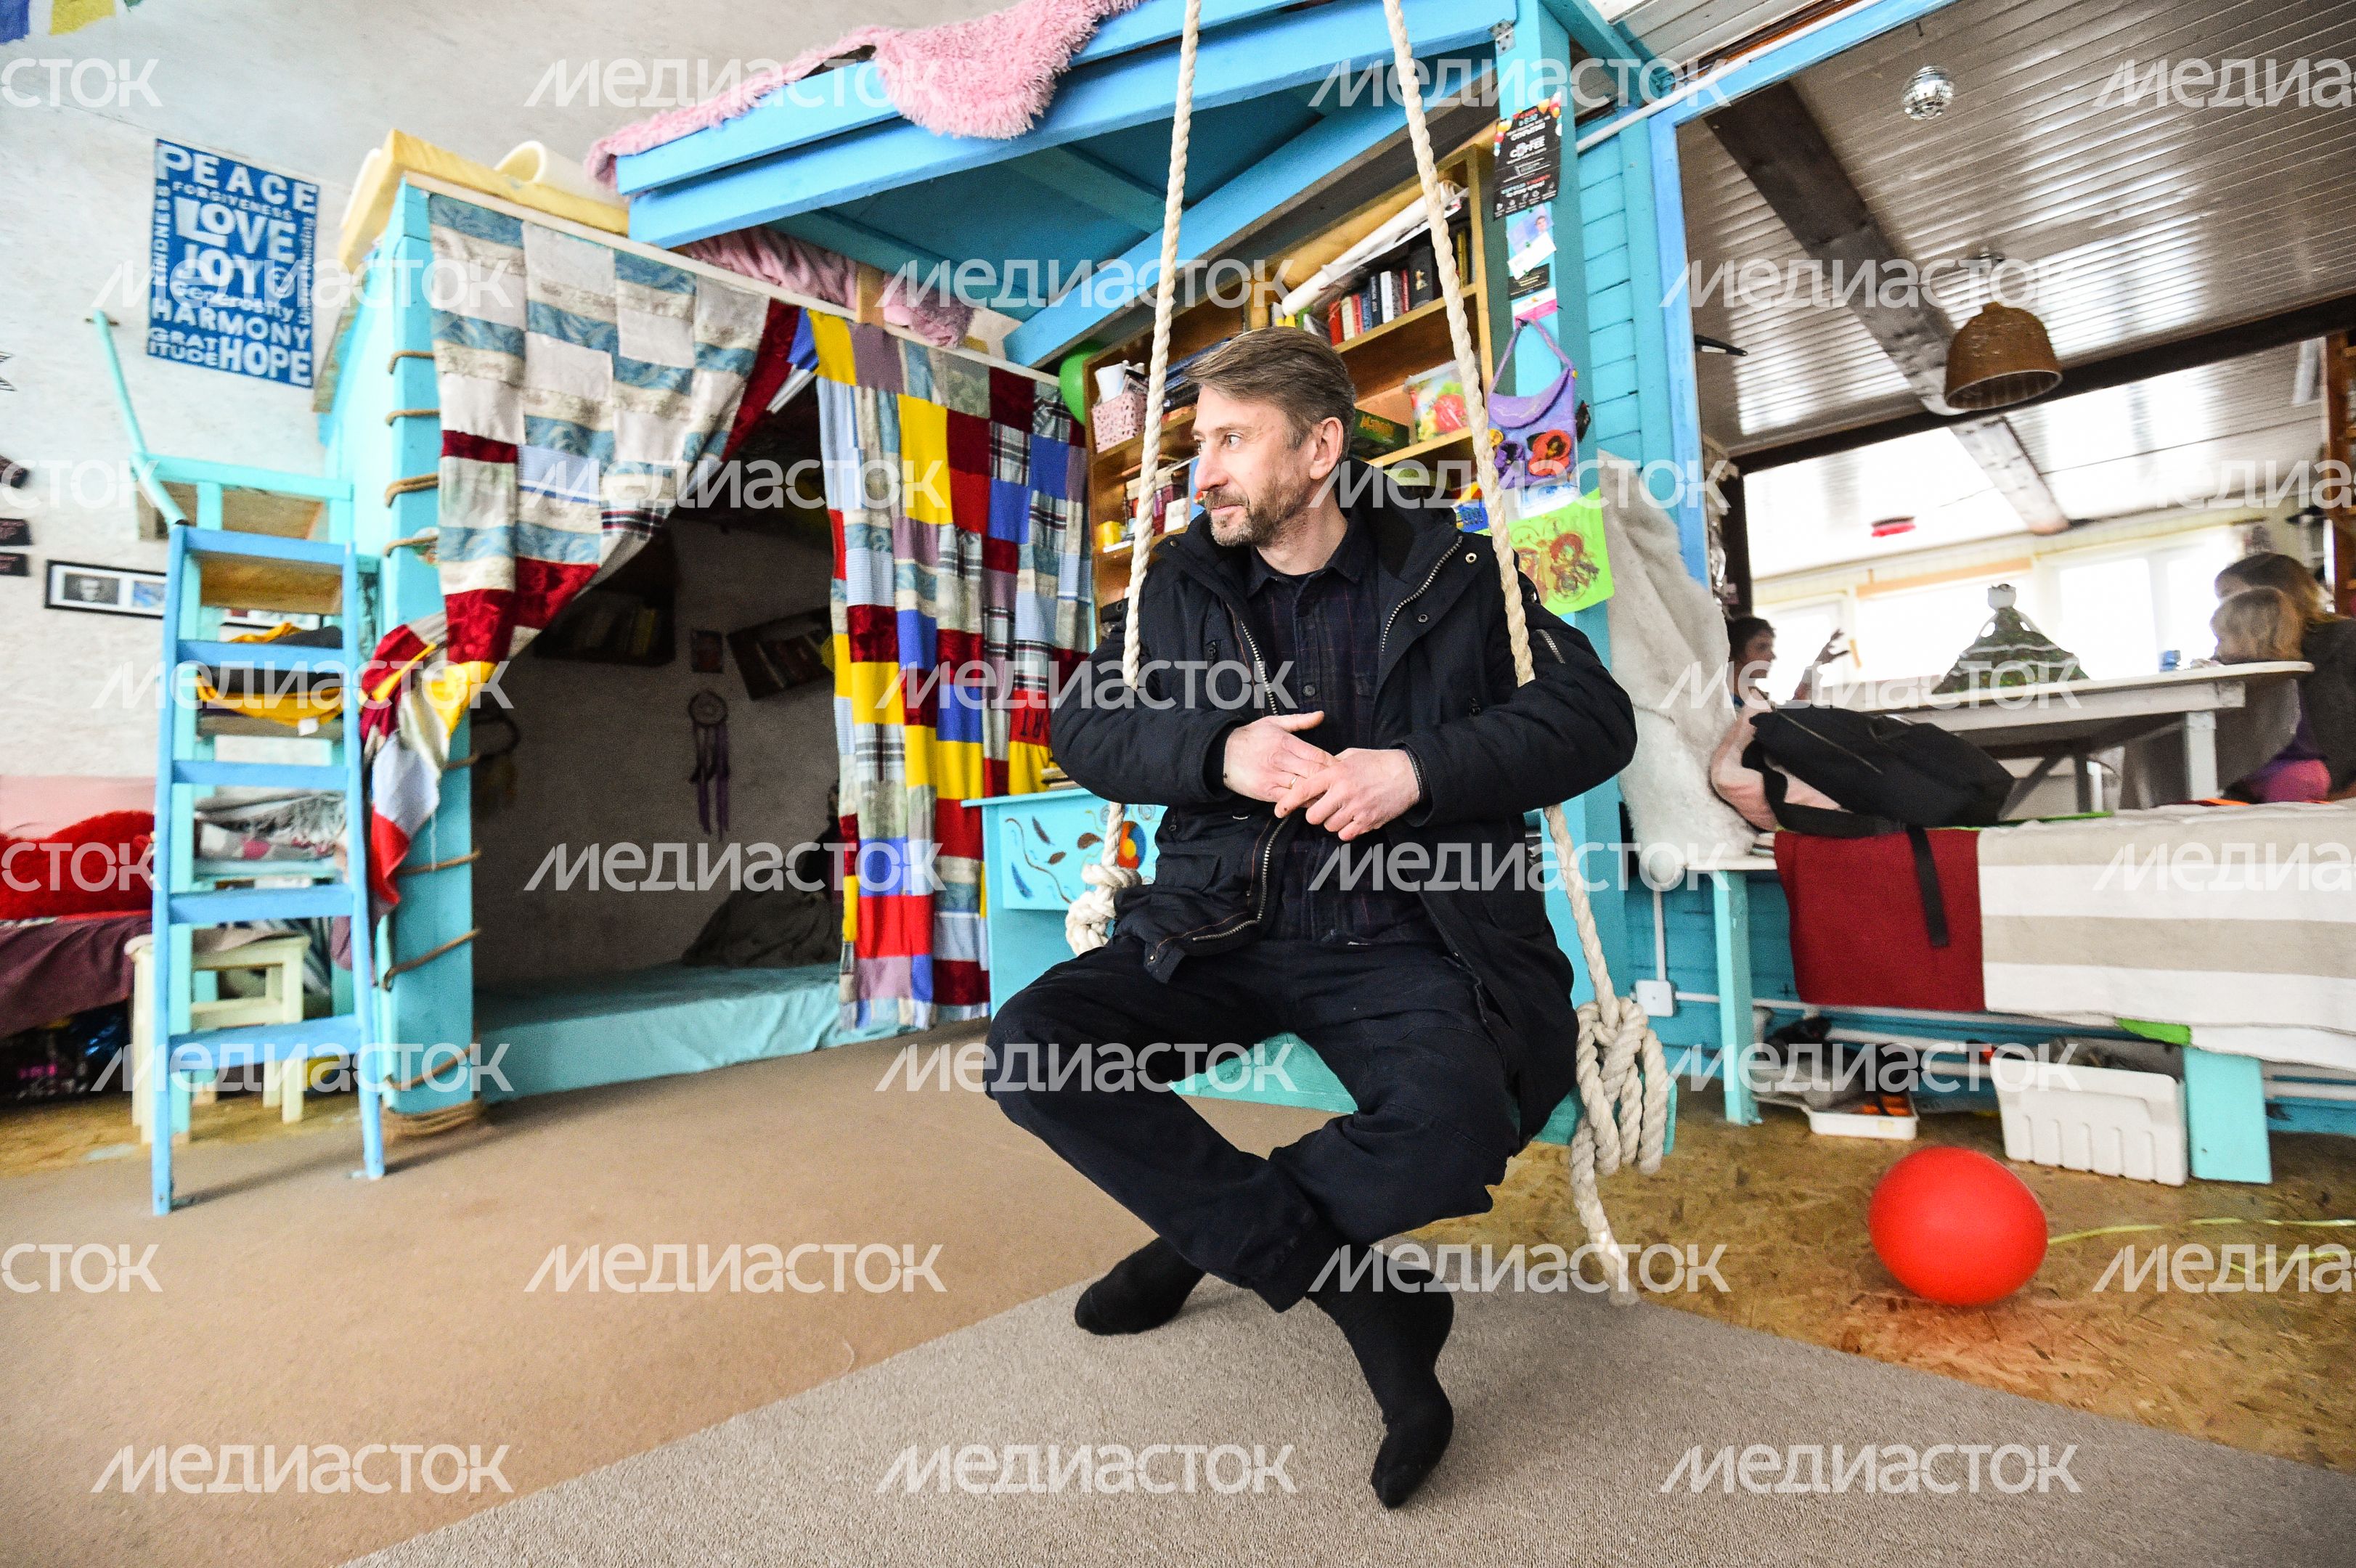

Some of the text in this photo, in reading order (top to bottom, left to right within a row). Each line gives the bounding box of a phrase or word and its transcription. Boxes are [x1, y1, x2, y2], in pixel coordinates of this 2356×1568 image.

[156, 144, 318, 213] PEACE
[173, 181, 292, 221] FORGIVENESS
[152, 185, 171, 287] KINDNESS
[174, 197, 296, 264] LOVE
[174, 244, 264, 295] JOY
[149, 327, 217, 351] GRAT
[151, 298, 311, 350] HARMONY
[147, 340, 218, 367] ITUDE
[219, 336, 311, 386] HOPE
